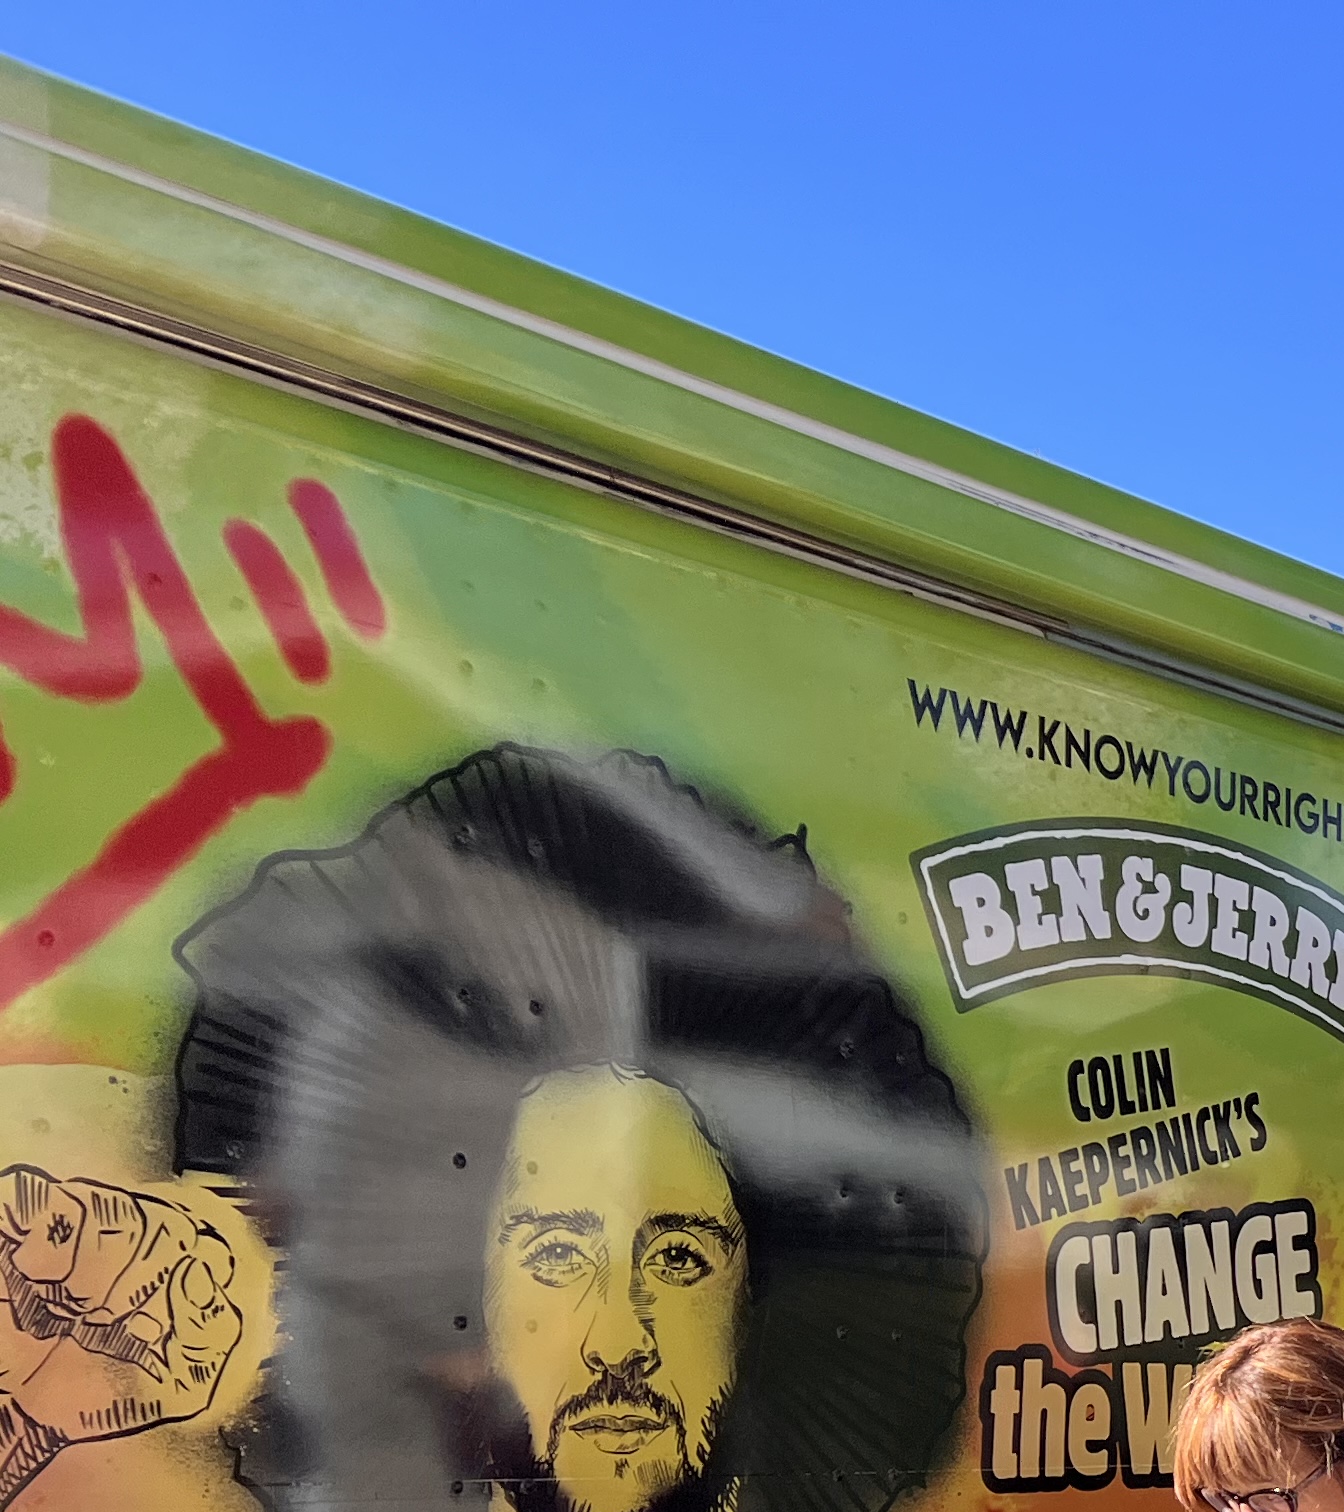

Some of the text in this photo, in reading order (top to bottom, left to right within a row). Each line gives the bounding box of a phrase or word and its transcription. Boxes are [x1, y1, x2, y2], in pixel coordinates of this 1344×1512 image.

[1067, 1047, 1177, 1123] COLIN
[1004, 1092, 1267, 1231] KAEPERNICK'S
[1054, 1210, 1316, 1354] CHANGE
[990, 1357, 1110, 1480] the
